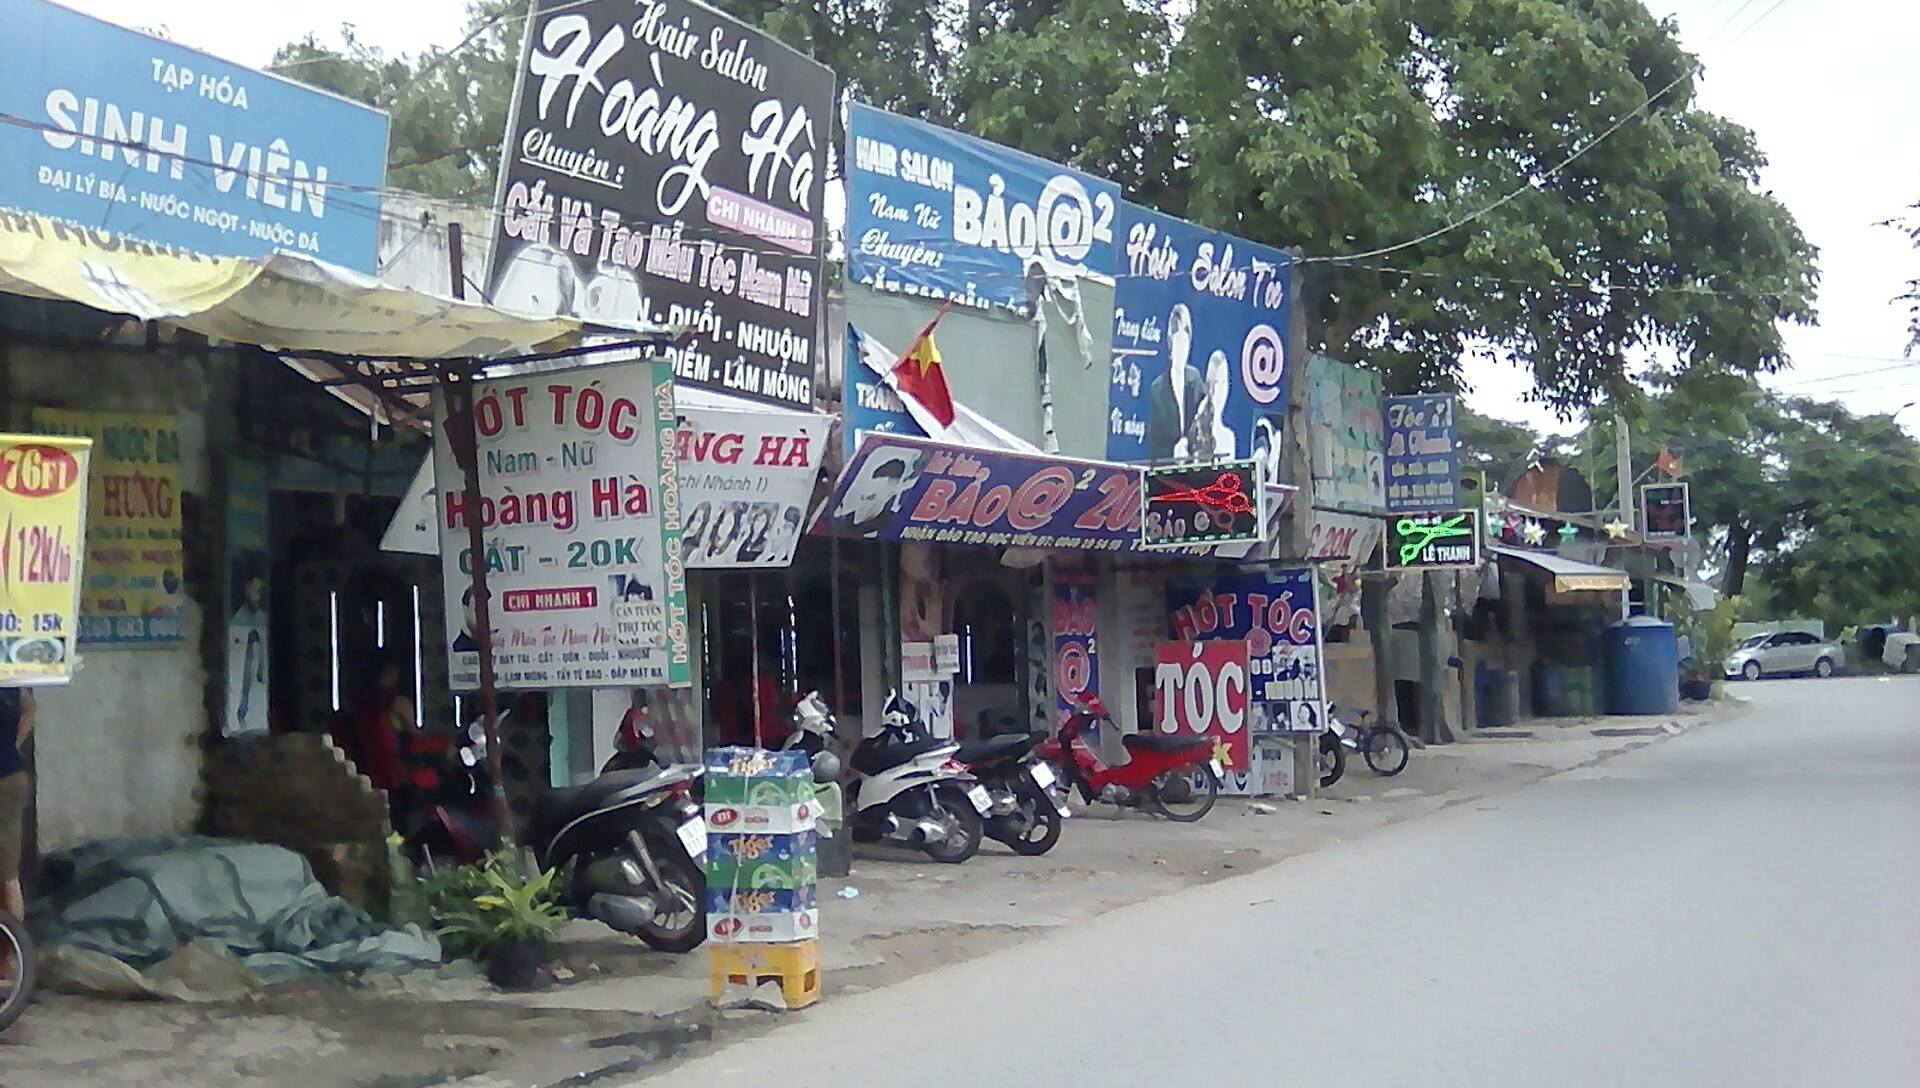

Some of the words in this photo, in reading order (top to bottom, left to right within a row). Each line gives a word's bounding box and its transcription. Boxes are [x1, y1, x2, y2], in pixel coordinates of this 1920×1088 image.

[632, 0, 700, 61] Hair
[701, 26, 769, 92] Salon
[151, 57, 194, 93] TẠP
[200, 72, 249, 110] HÓA
[530, 14, 719, 216] Hoàng
[742, 100, 816, 212] Hà
[42, 89, 187, 181] SINH
[209, 134, 328, 218] VIÊN
[856, 135, 897, 177] HAIR
[901, 149, 953, 192] SALON
[38, 165, 71, 193] ĐẠI
[75, 172, 96, 195] LÝ
[99, 180, 127, 204] BIA
[140, 190, 190, 221] NƯỚC
[193, 207, 238, 235] NGỌT
[249, 218, 295, 249] NƯỚC
[298, 228, 320, 253] ĐÁ
[709, 195, 739, 221] CHI
[869, 192, 909, 222] Nam
[504, 178, 554, 245] Cắt
[560, 196, 593, 256] Và
[699, 239, 737, 295] Tóc
[738, 252, 782, 308] Nam
[737, 321, 810, 368] NHUỘM
[548, 380, 638, 441] TÓC
[487, 449, 537, 475] Nam
[561, 441, 595, 469] Nữ
[676, 420, 744, 465] ÀNG
[754, 428, 810, 467] HÀ
[446, 486, 575, 530] Hoàng
[591, 475, 648, 518] Hà
[703, 475, 750, 491] Nhánh
[1074, 474, 1143, 533] 20
[567, 537, 640, 569] 20K
[1248, 590, 1314, 643] TÓC
[1156, 641, 1244, 734] TÓC
